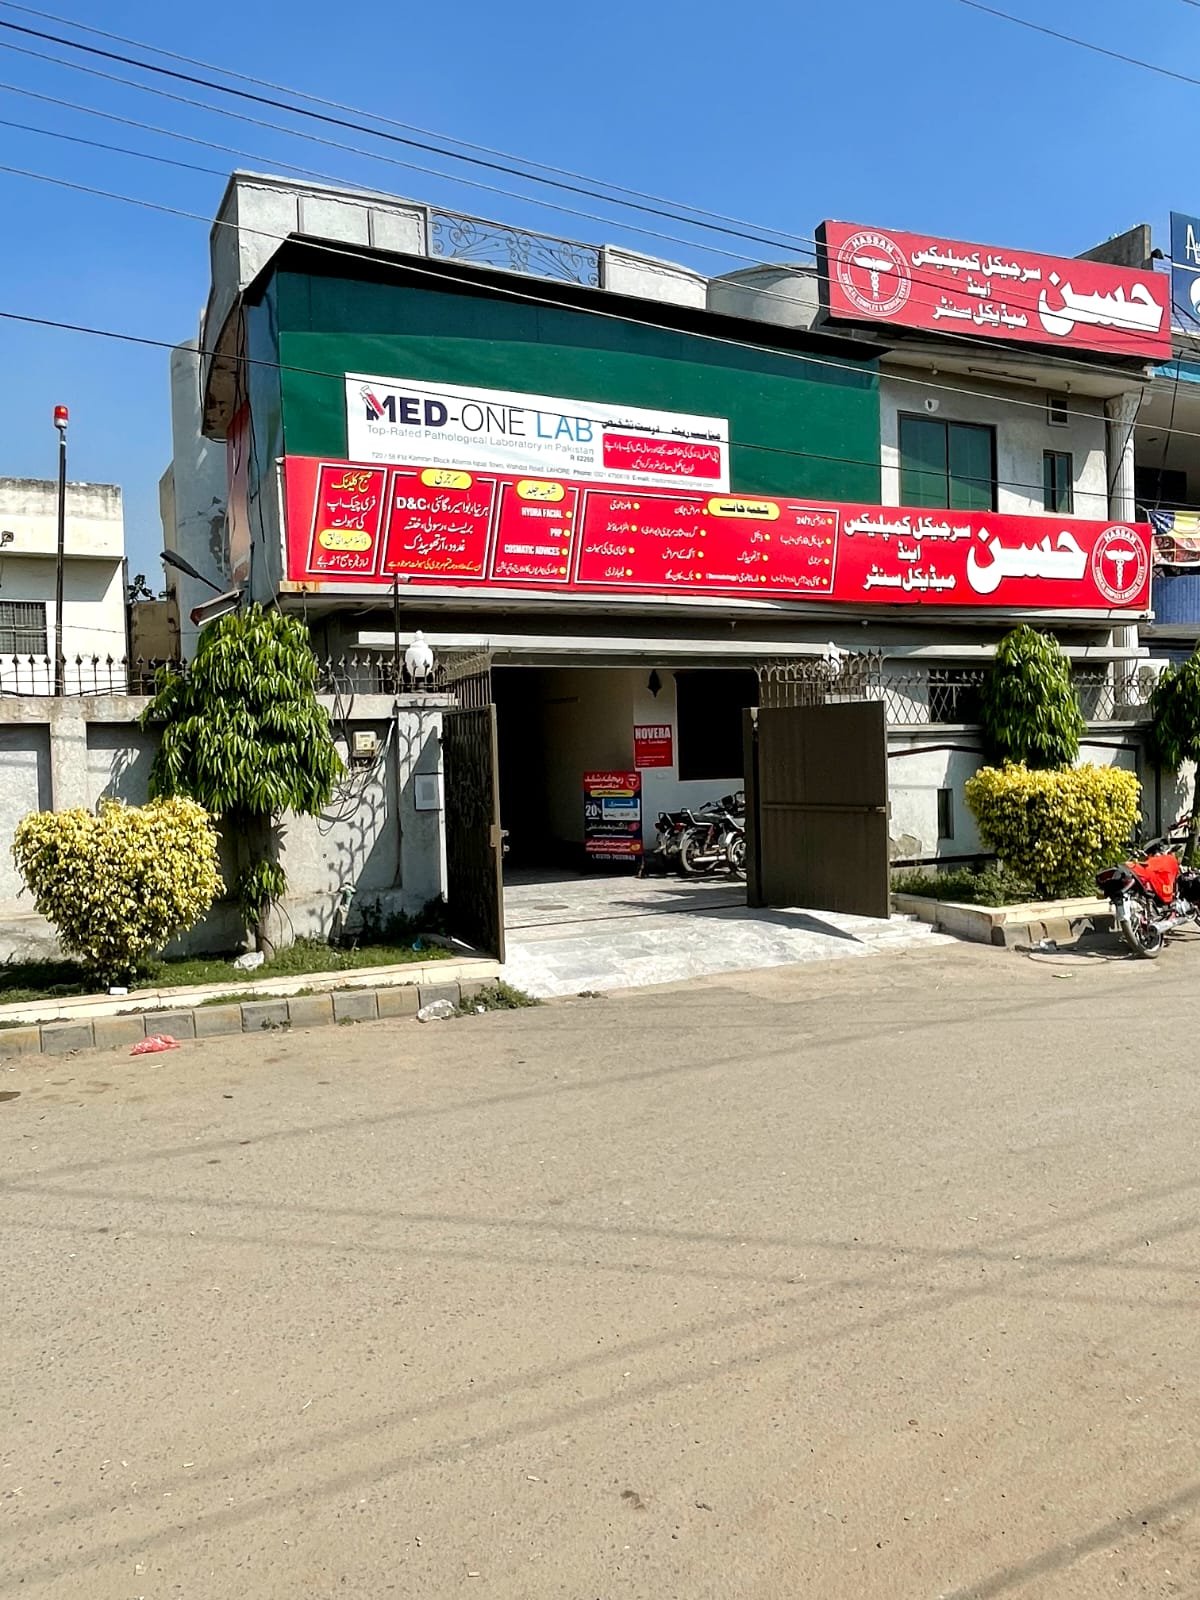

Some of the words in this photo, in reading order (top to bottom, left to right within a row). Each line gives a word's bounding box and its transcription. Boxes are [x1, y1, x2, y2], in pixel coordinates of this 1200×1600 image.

[851, 235, 895, 254] HASSAN
[911, 245, 981, 276] کمپلیکس
[982, 254, 1042, 282] سرجیکل
[967, 275, 992, 297] اینڈ
[932, 295, 973, 320] سنٹر
[974, 302, 1030, 328] میڈیکل
[1038, 272, 1164, 336] حسن
[364, 393, 526, 437] MED-ONE
[536, 411, 595, 443] LAB
[367, 424, 422, 439] Top-Rated
[424, 430, 487, 446] Pathological
[490, 436, 542, 453] Laboratory
[543, 443, 553, 451] in
[555, 443, 595, 455] Pakistan
[331, 472, 359, 491] کلینک
[326, 497, 341, 512] اپ
[341, 495, 361, 512] چیک
[360, 495, 376, 511] فری
[396, 496, 427, 511] D&C
[331, 514, 357, 528] سہولت
[355, 512, 367, 529] کی
[844, 513, 911, 542] کمپلیکس
[912, 518, 972, 542] سرجیکل
[897, 541, 921, 563] اینڈ
[966, 527, 1089, 594] حسن
[863, 565, 902, 591] سنٹر
[903, 564, 957, 592] میڈیکل
[634, 726, 672, 740] NOVERA
